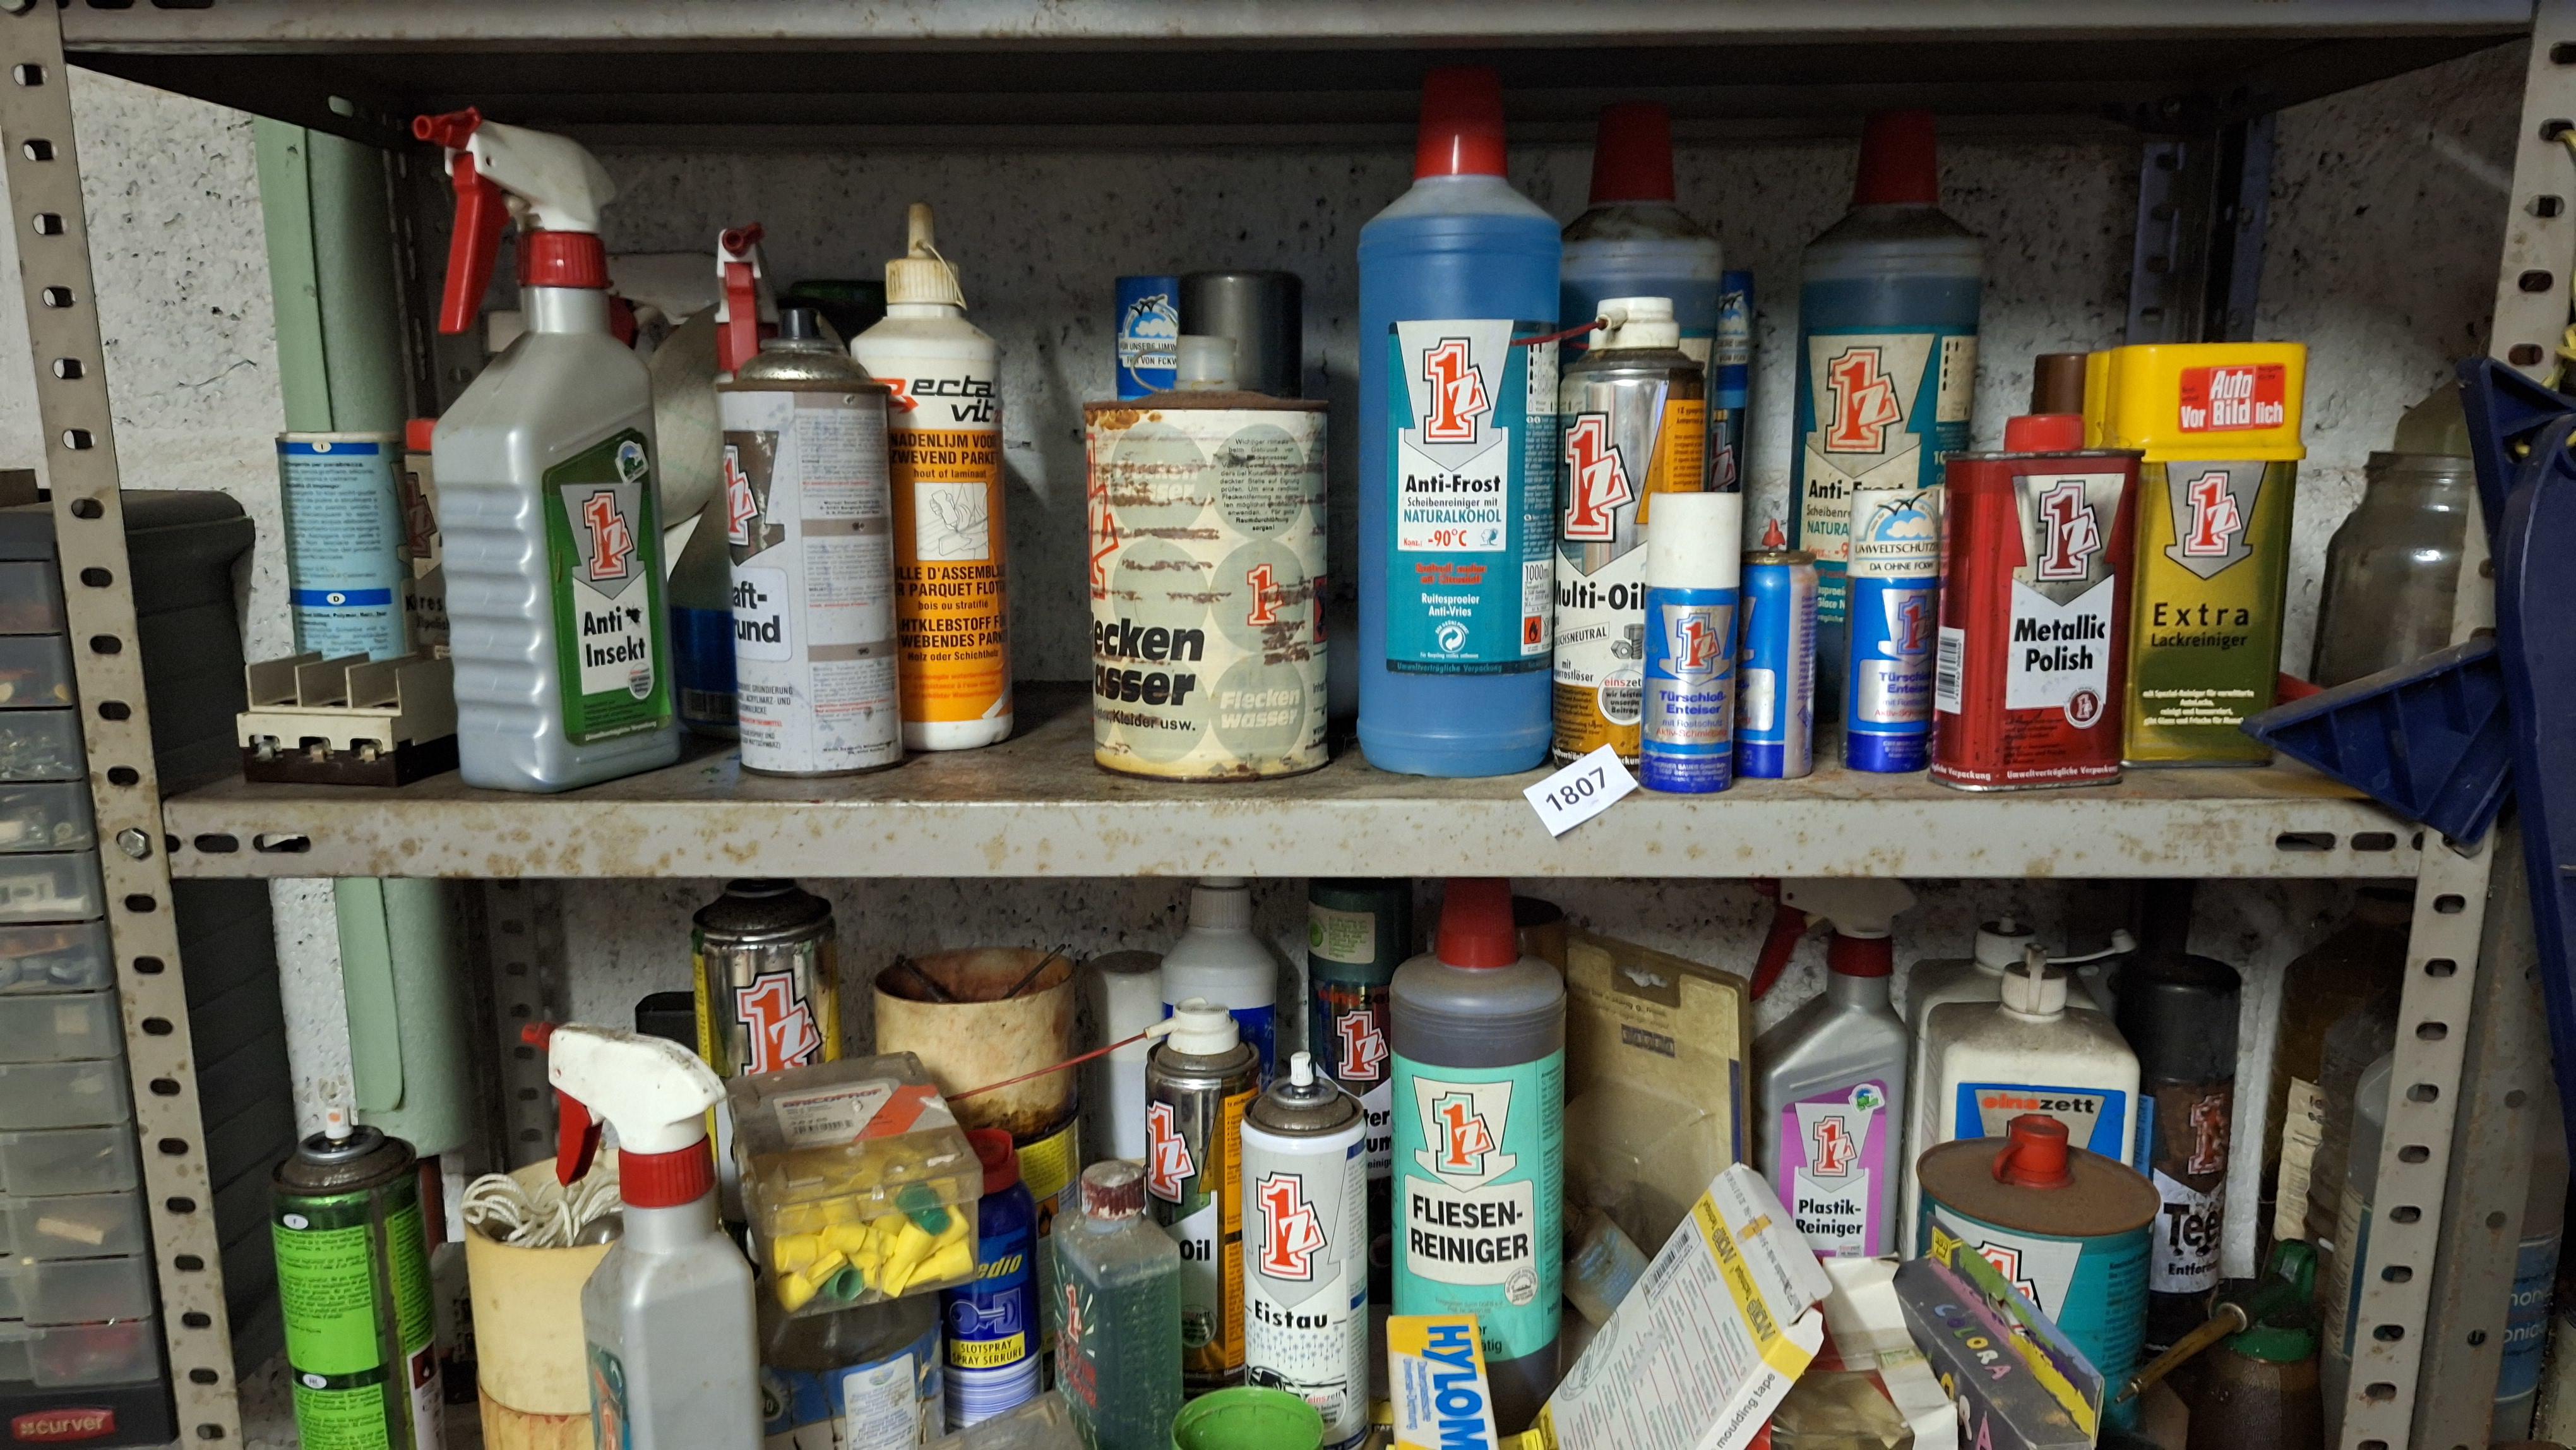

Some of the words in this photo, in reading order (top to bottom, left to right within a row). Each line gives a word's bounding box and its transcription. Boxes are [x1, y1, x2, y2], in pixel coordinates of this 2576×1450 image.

[1141, 355, 1155, 365] VON
[2211, 369, 2253, 400] Auto
[951, 398, 994, 422] vit
[2181, 405, 2206, 428] Vor
[2213, 398, 2251, 426] Bild
[2255, 400, 2284, 424] lich
[914, 468, 935, 478] hout
[939, 468, 947, 478] of
[1405, 473, 1501, 493] Anti-Frost
[1808, 479, 1904, 500] Anti-F
[1407, 496, 1480, 509] Scheibenreiniger
[1484, 498, 1498, 507] mit
[1403, 508, 1502, 524] NATURALKOHOL
[1427, 528, 1467, 548] -90°C
[1869, 562, 1881, 572] DA
[1884, 561, 1912, 571] OHNE
[910, 582, 973, 598] PARQUET
[918, 601, 938, 611] bois
[2152, 602, 2250, 626] Extra
[583, 605, 623, 637] Anti
[2013, 613, 2106, 642] Metallic
[1092, 614, 1205, 662] ecken
[2151, 632, 2248, 650] Lackreiniger
[585, 635, 646, 668] Insekt
[907, 652, 927, 661] Holz
[930, 652, 951, 661] oder
[2025, 645, 2094, 673] Polish
[1562, 657, 1571, 669] mit
[777, 696, 791, 705] UND
[1219, 687, 1300, 709] Flecken
[1220, 708, 1298, 729] wasser
[1611, 707, 1638, 715] Beitrag
[1666, 703, 1722, 715] Enteiser
[1160, 719, 1196, 732] usw.
[1545, 765, 1607, 812] 1807
[1982, 1093, 2096, 1114] einszett
[1412, 1193, 1524, 1230] FLIESEN-
[1798, 1198, 1861, 1215] Plastik-
[1796, 1218, 1863, 1238] Reiniger
[1179, 1238, 1211, 1262] Oil
[1410, 1226, 1529, 1264] REINIGER
[1254, 1299, 1328, 1329] Eistau
[960, 1338, 1013, 1355] SLOTSPRAY
[952, 1353, 980, 1365] SPRAY
[1717, 1398, 1758, 1449] moulding
[1753, 1373, 1775, 1398] tape
[36, 1416, 104, 1435] curver
